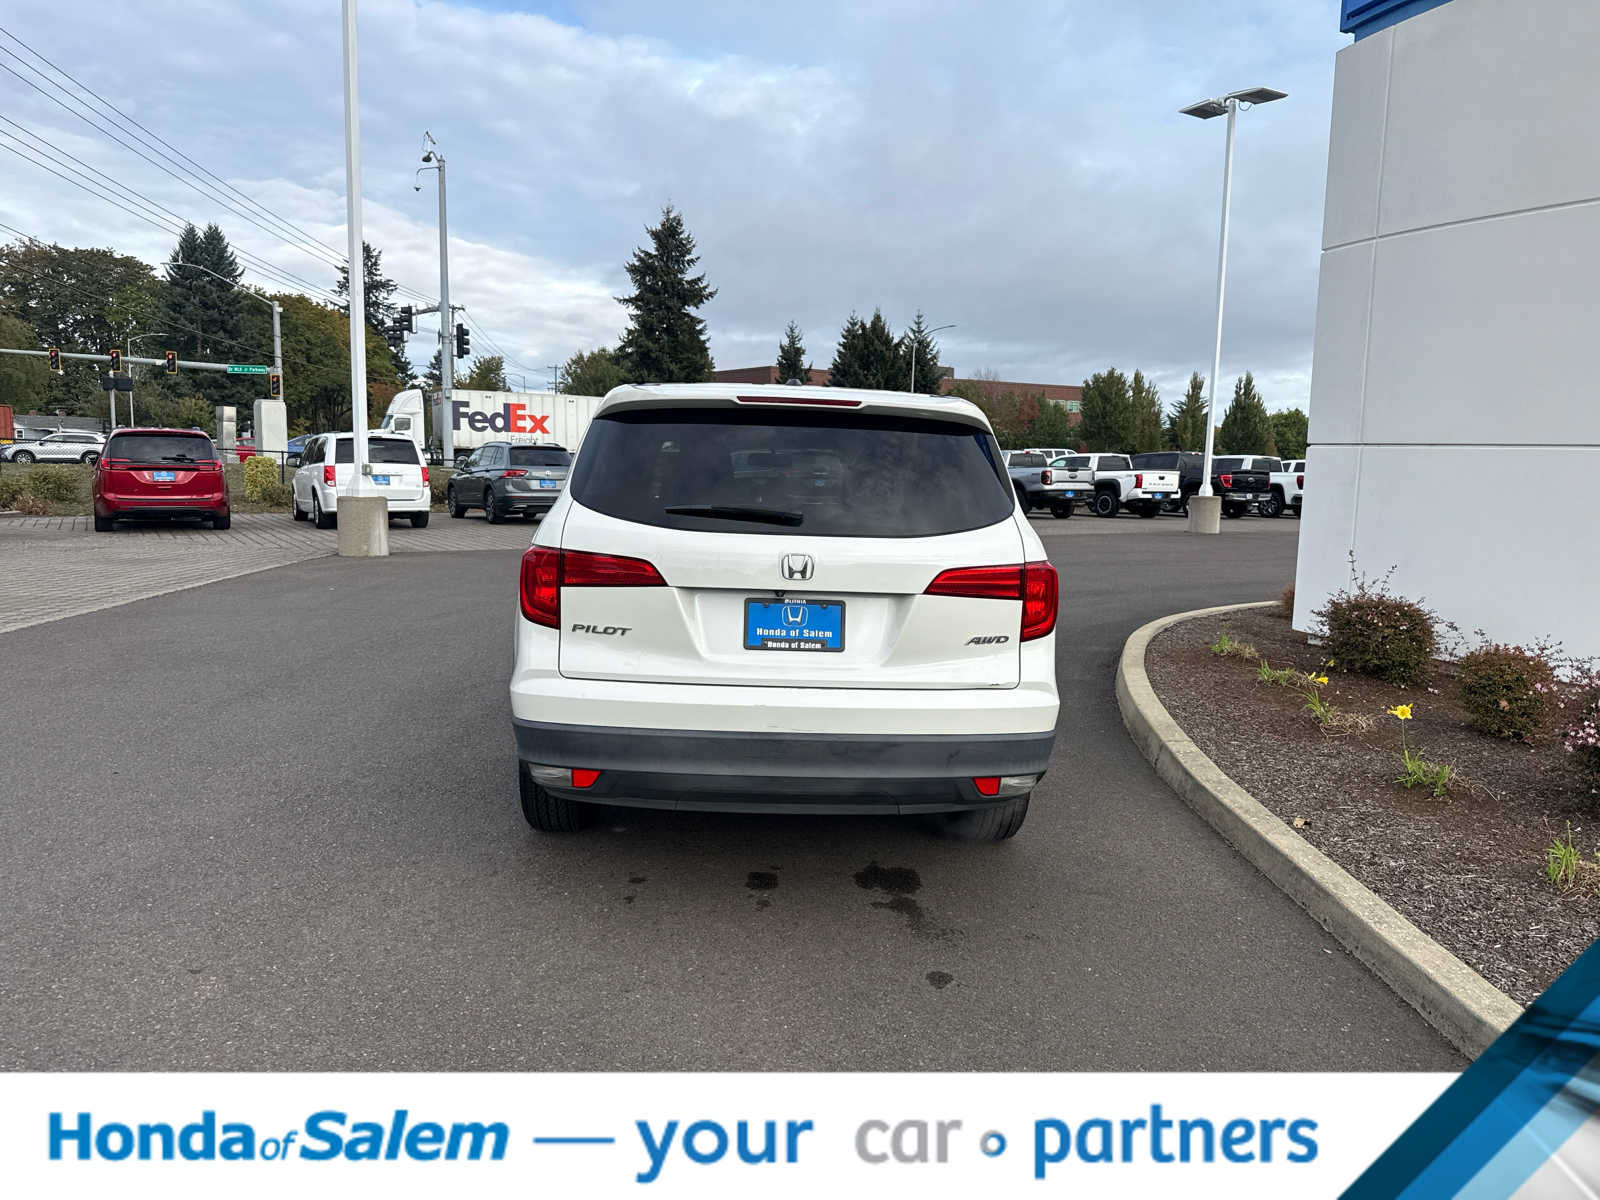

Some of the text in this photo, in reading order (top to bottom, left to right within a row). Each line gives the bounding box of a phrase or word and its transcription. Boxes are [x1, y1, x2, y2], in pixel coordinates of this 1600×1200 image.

[452, 401, 550, 434] FedEx
[571, 624, 632, 636] PILOT
[756, 627, 832, 638] Honda of Salem
[767, 641, 822, 649] Honda of Salem
[964, 635, 1010, 646] AWD
